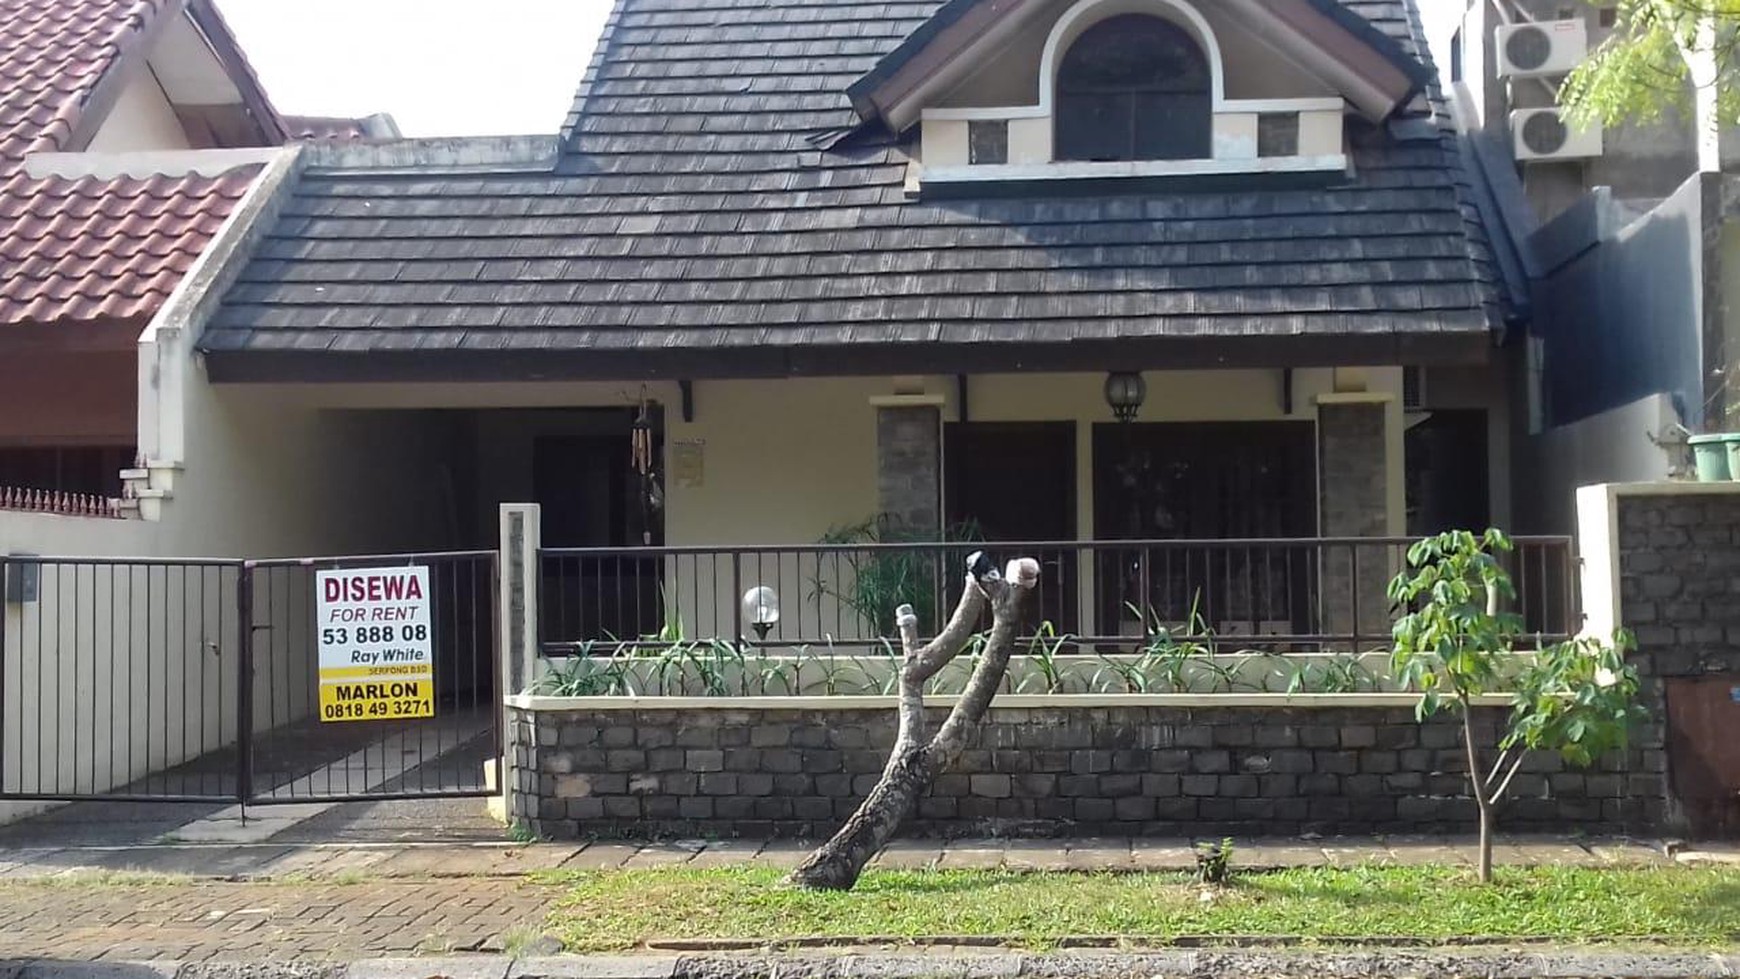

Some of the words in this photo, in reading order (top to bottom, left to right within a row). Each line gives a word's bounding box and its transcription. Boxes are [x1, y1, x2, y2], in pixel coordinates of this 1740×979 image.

[324, 575, 423, 603] DISEWA
[330, 608, 366, 623] FOR
[371, 606, 419, 621] RENT
[323, 628, 348, 645] 53
[356, 626, 394, 643] 888
[402, 625, 427, 642] 08
[351, 650, 380, 665] Ray
[383, 648, 424, 662] White
[336, 682, 418, 701] MARLON
[325, 703, 363, 718] 0818
[369, 701, 387, 716] 49
[394, 699, 430, 715] 3271
